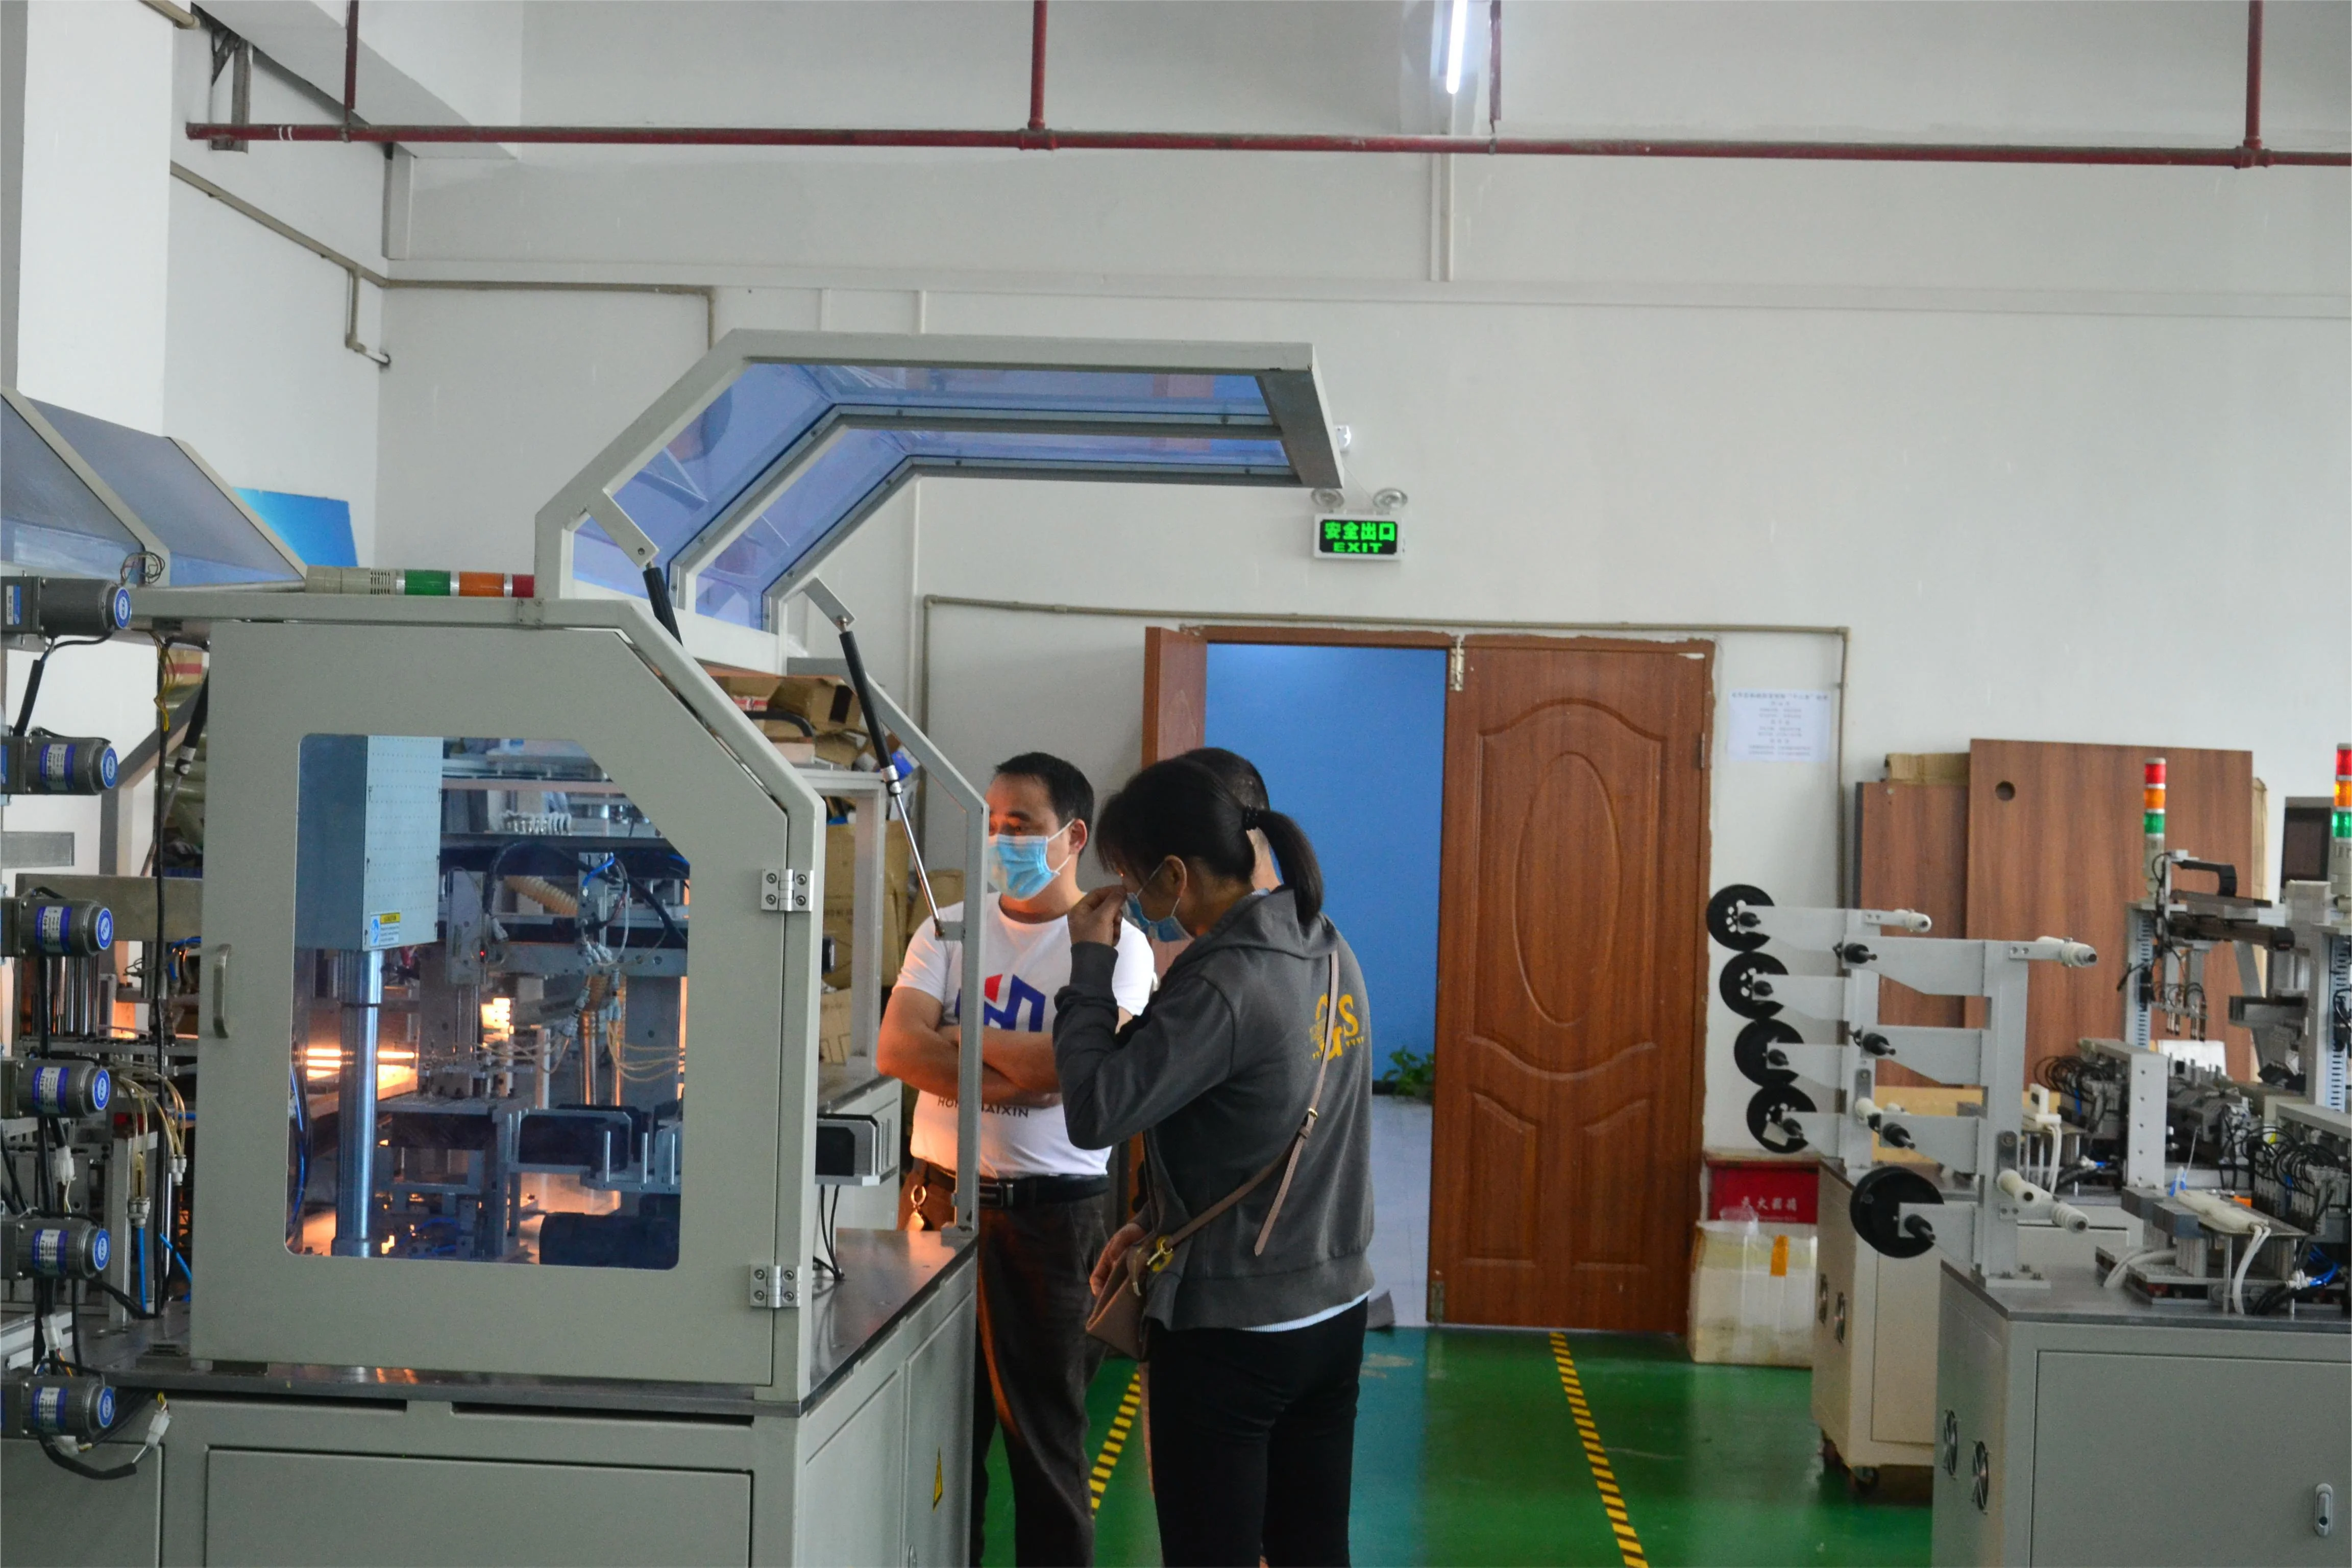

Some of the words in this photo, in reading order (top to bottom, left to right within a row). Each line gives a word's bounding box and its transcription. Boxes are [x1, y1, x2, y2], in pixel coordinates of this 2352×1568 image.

[1325, 521, 1395, 542] 安全出口
[1333, 541, 1382, 553] EXIT
